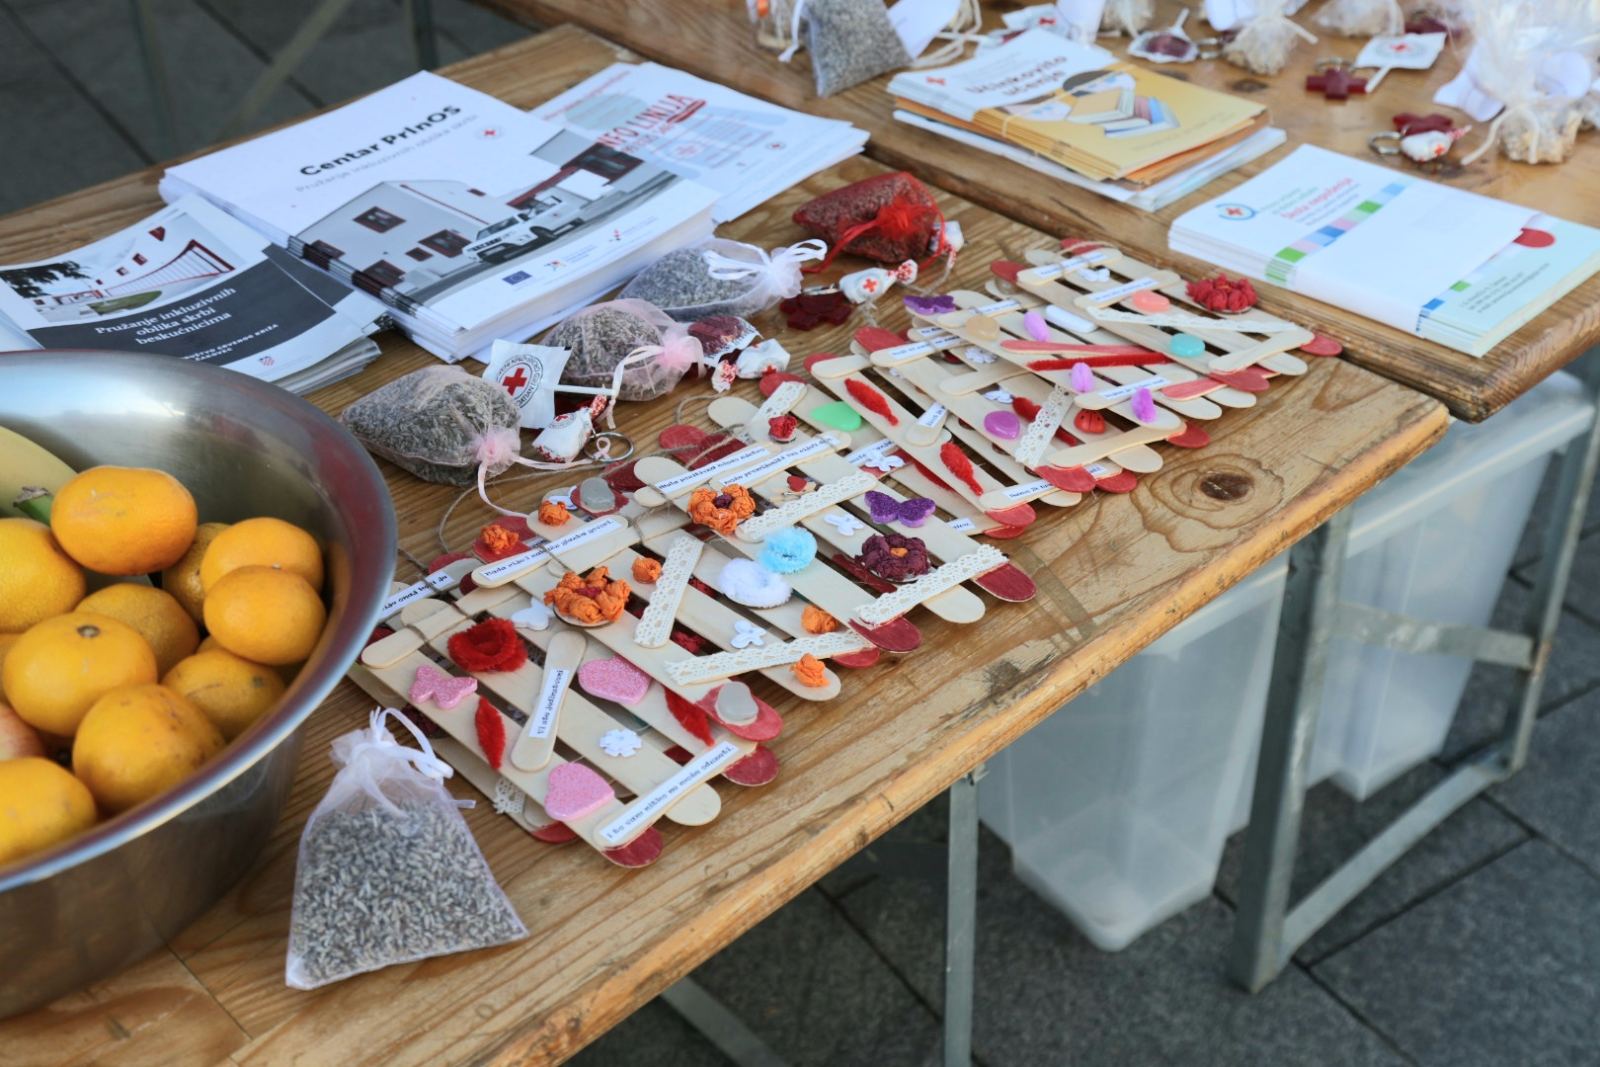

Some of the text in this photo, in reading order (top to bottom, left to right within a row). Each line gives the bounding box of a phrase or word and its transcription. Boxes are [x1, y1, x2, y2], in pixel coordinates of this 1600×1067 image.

[300, 143, 381, 176] Centar
[95, 286, 237, 335] Pružanje inkluzivnih
[136, 306, 217, 336] oblika skrbi
[135, 312, 232, 345] beskućnicima
